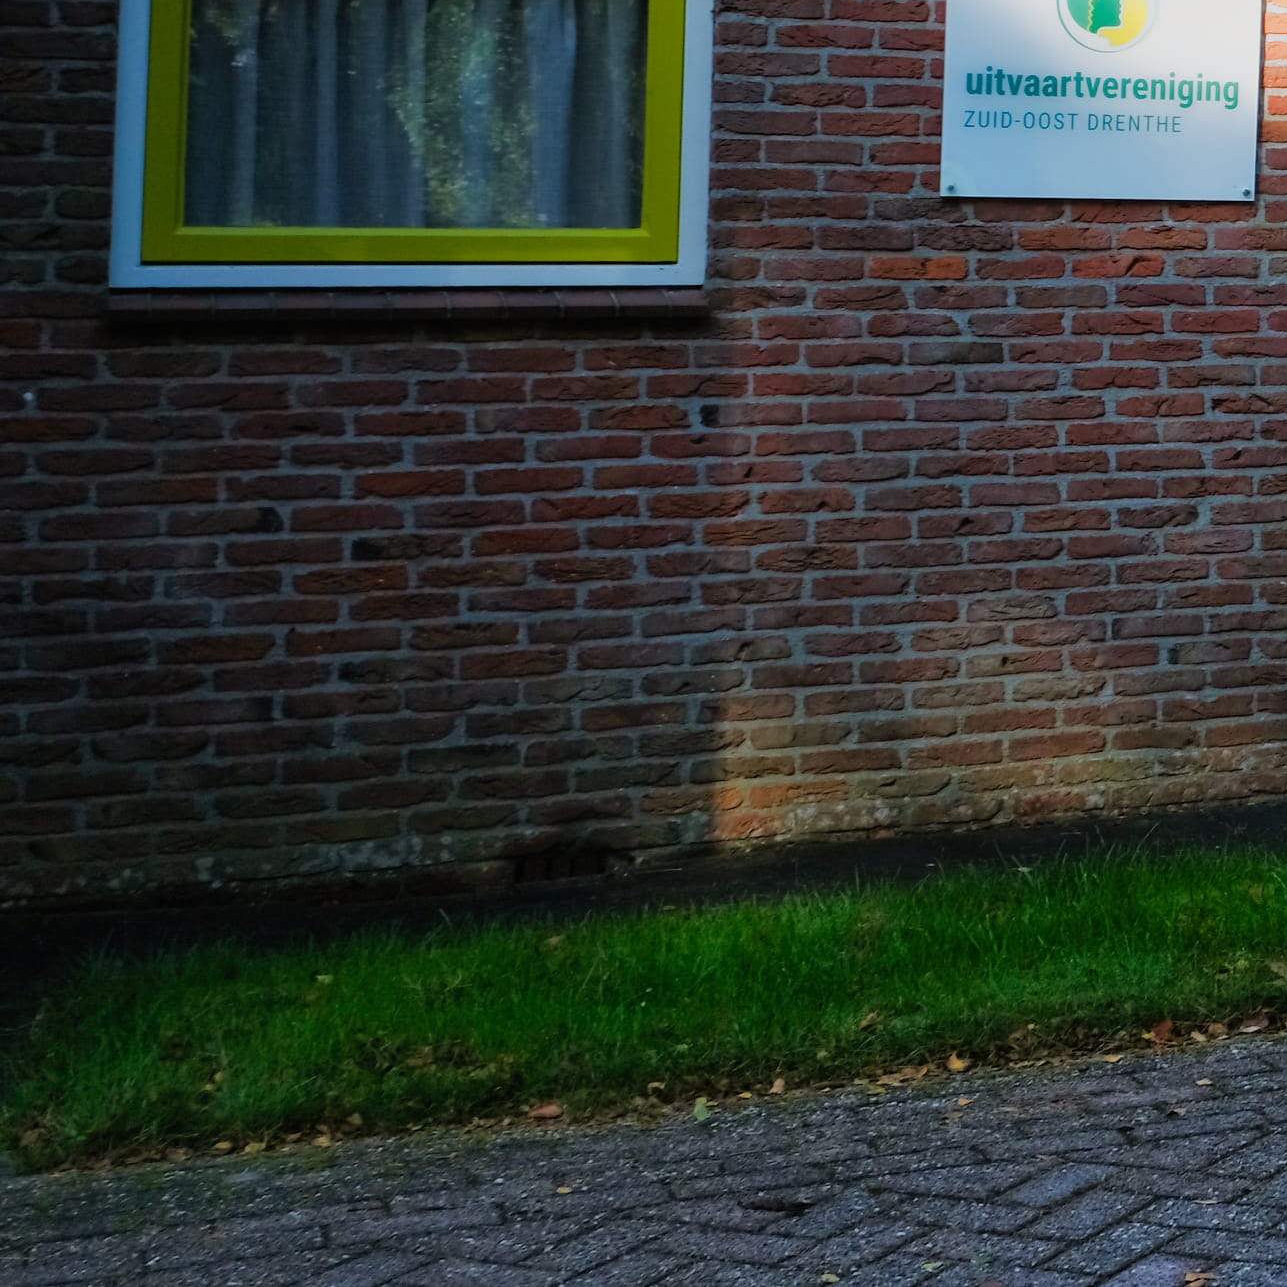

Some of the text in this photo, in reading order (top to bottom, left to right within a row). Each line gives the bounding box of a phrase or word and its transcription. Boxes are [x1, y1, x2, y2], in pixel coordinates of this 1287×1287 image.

[966, 66, 1239, 109] uitvaartvereniging
[964, 110, 1182, 133] ZUID-OOST DRENTHE
